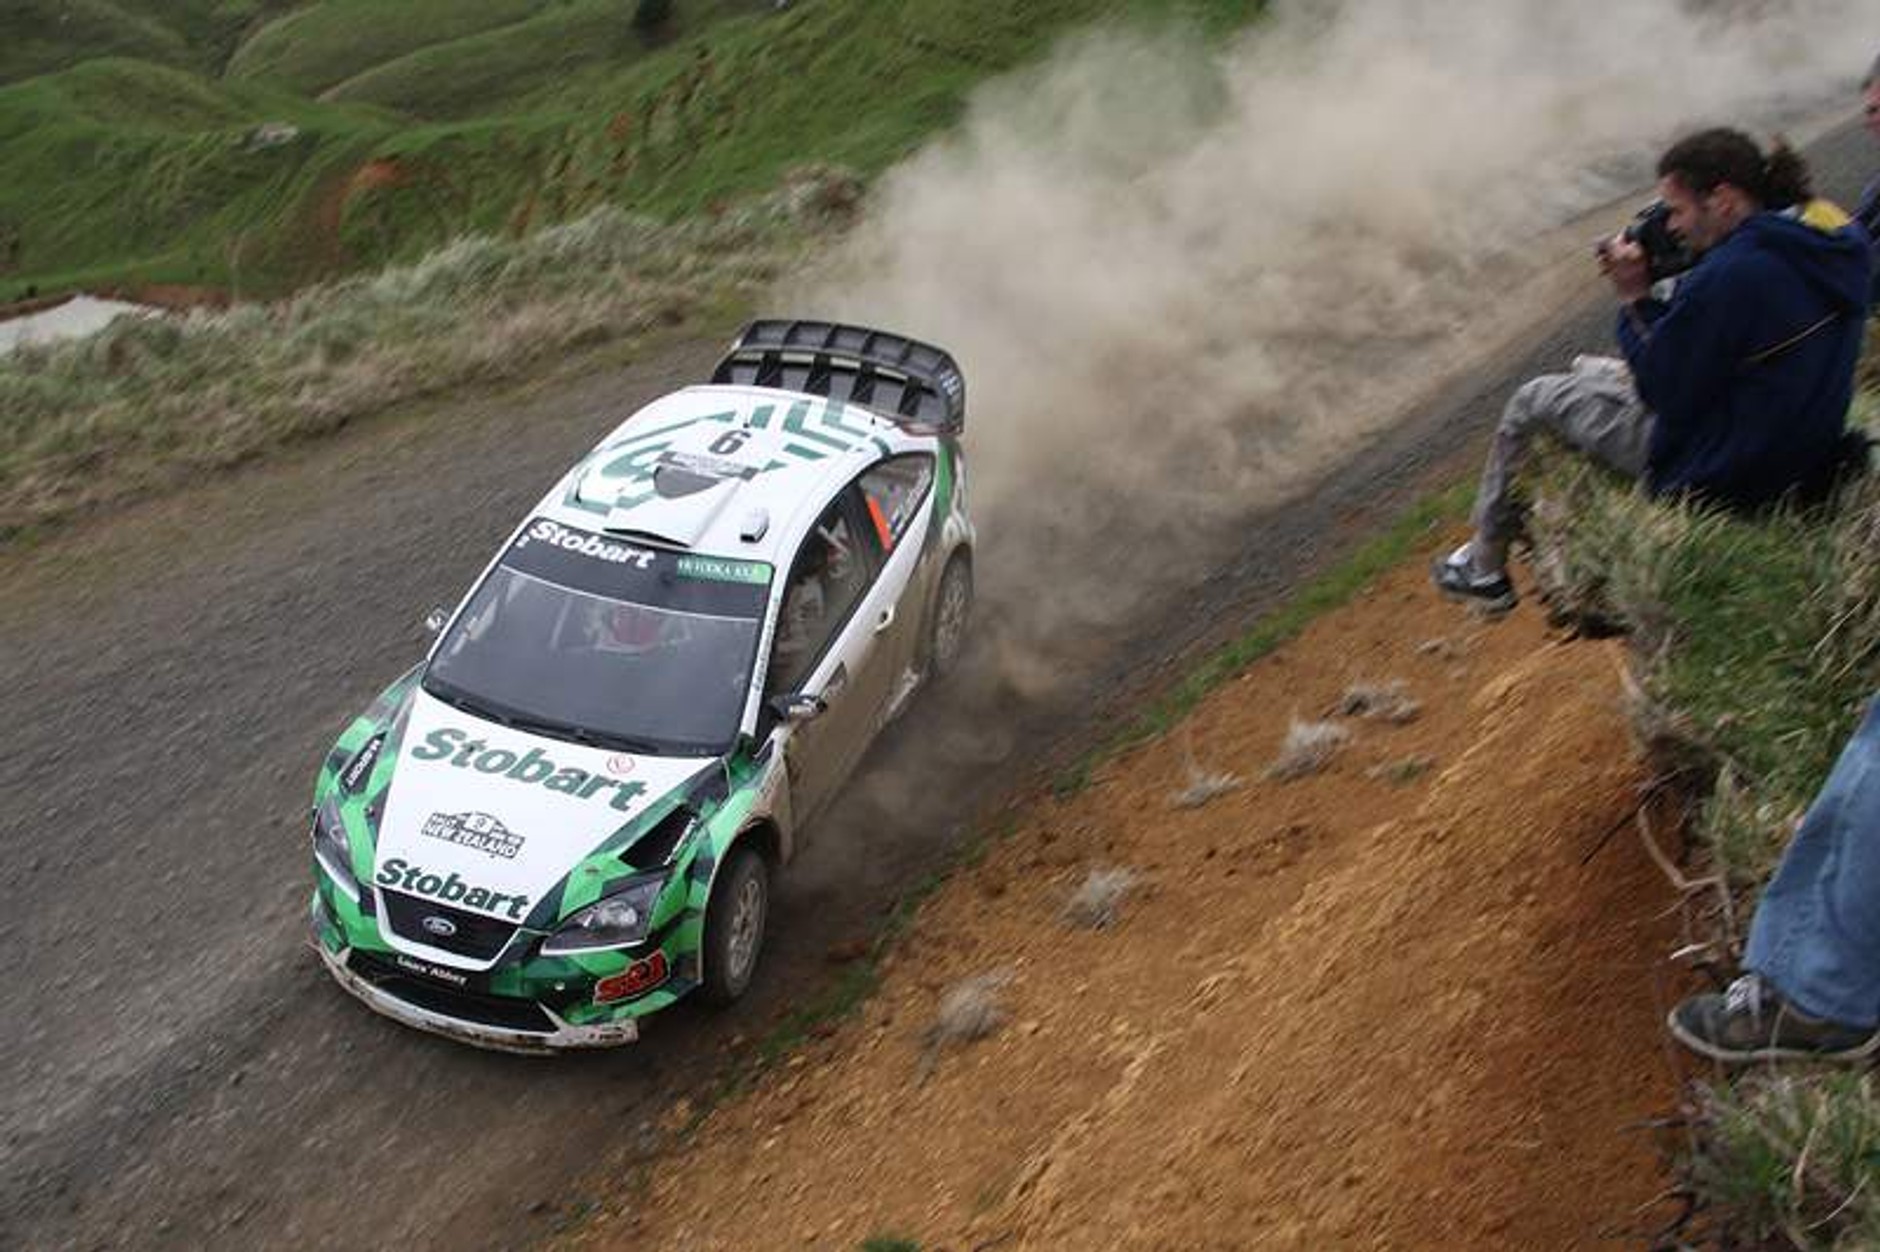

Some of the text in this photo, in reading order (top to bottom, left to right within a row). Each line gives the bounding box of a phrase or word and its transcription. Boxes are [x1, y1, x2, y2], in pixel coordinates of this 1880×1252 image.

[529, 521, 655, 568] Stobart
[411, 728, 647, 811] Stobart
[376, 858, 529, 919] Stobart
